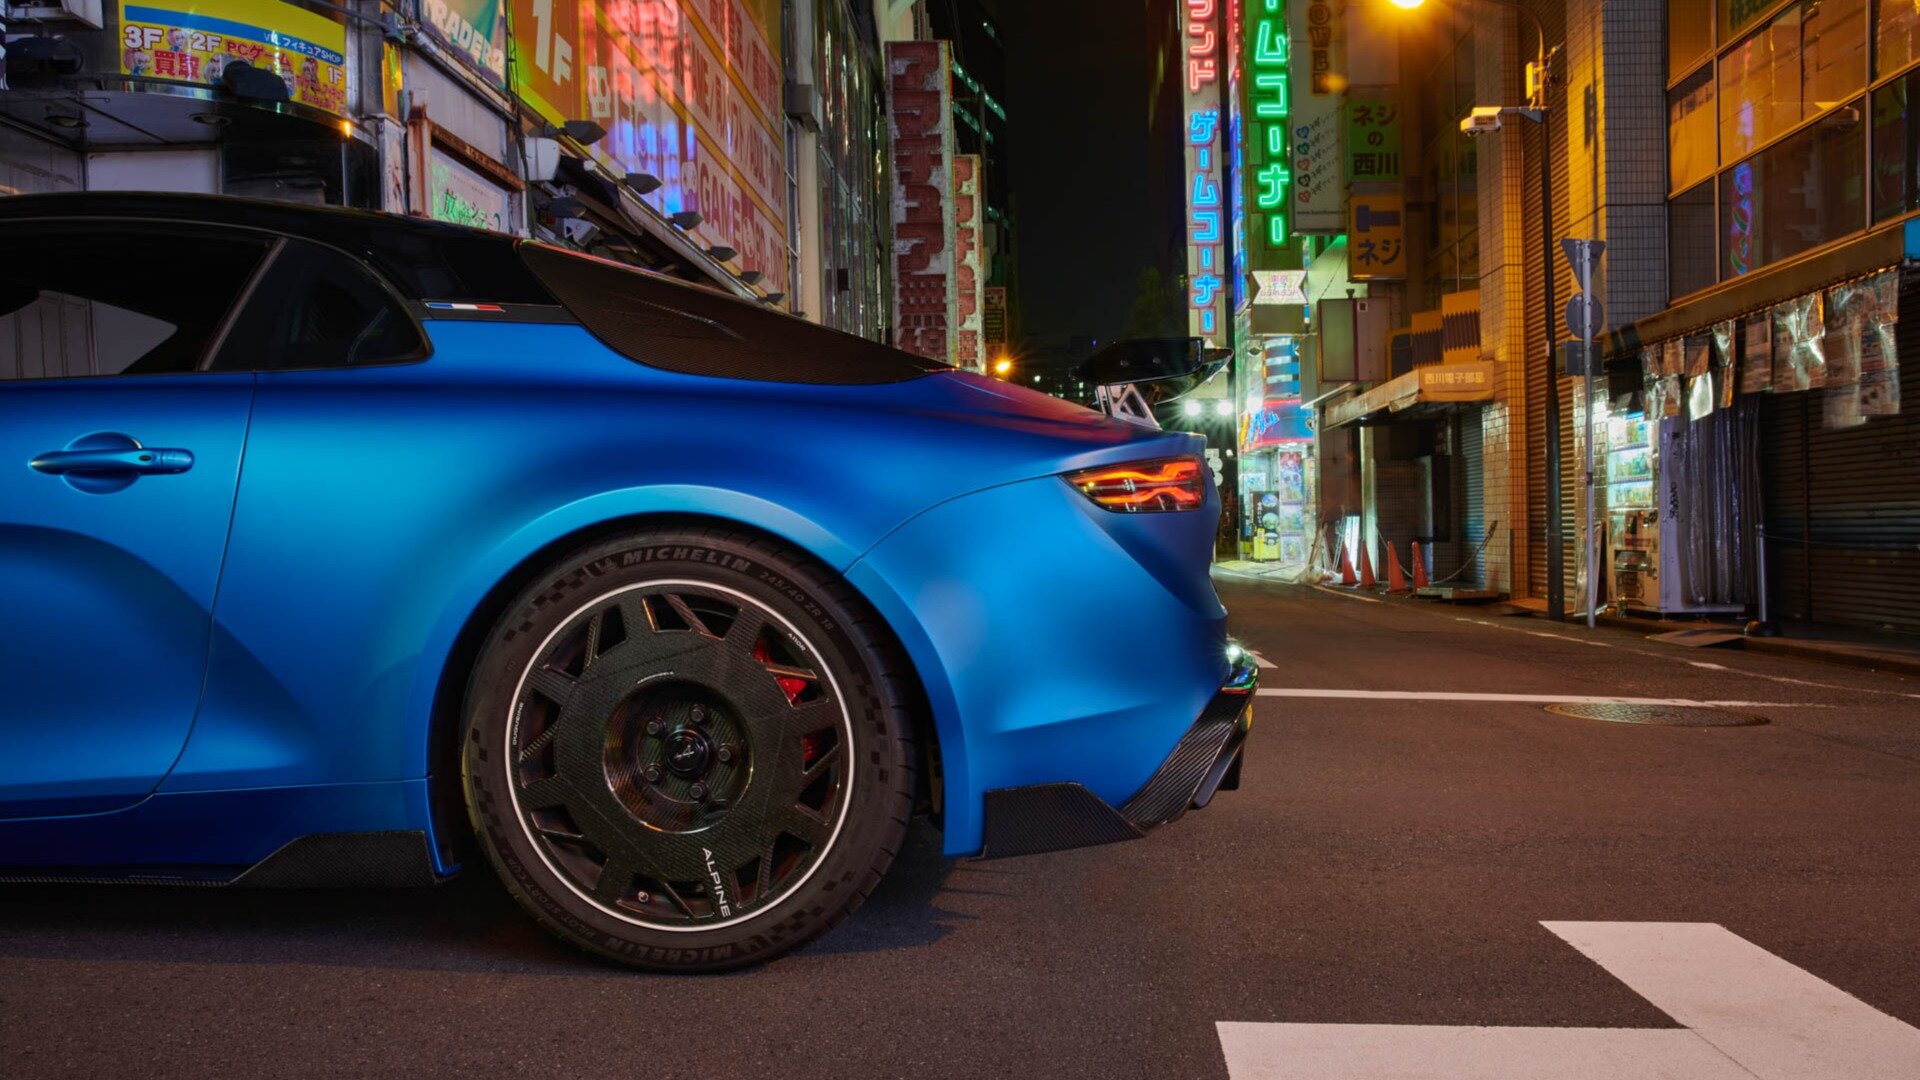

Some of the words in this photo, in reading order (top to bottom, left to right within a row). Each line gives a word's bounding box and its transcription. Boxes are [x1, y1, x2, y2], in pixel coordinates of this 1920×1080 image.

[124, 25, 163, 51] 3F
[191, 33, 222, 52] 2F
[532, 0, 573, 87] 1F
[153, 51, 200, 80] 買取
[327, 66, 343, 85] 1F
[1353, 104, 1398, 127] ネジ
[1367, 131, 1384, 146] の
[1353, 152, 1399, 176] 西川
[700, 162, 741, 252] GAME
[1189, 111, 1221, 332] ゲームコーナー
[1357, 238, 1401, 267] ネジ
[622, 547, 751, 572] MICHELIN
[803, 599, 823, 619] ZR
[702, 847, 731, 918] ALPINE
[604, 936, 733, 963] MICHELIN
